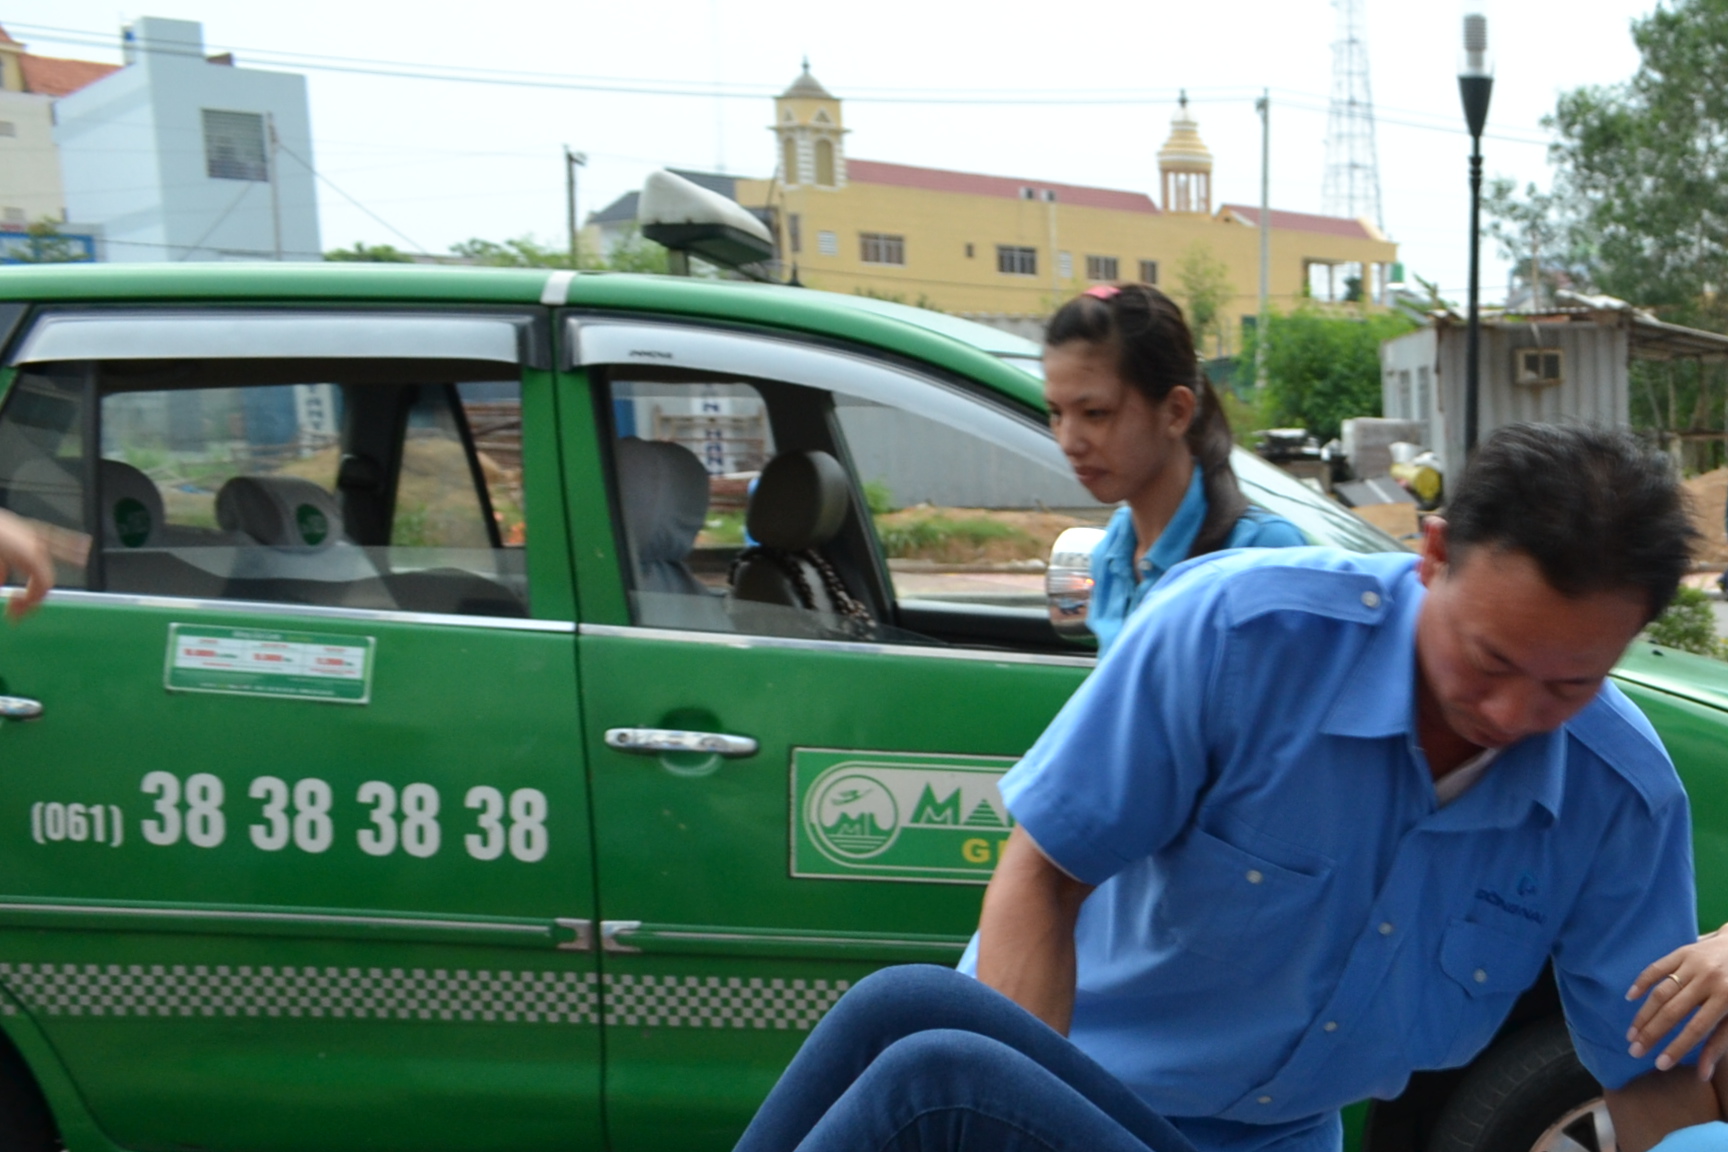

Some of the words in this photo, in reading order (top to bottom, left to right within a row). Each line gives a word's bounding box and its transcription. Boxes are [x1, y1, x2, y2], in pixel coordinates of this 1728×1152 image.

[31, 801, 123, 848] (061)
[140, 771, 226, 848] 38
[248, 775, 333, 854] 38
[356, 780, 441, 858] 38
[464, 785, 549, 863] 38
